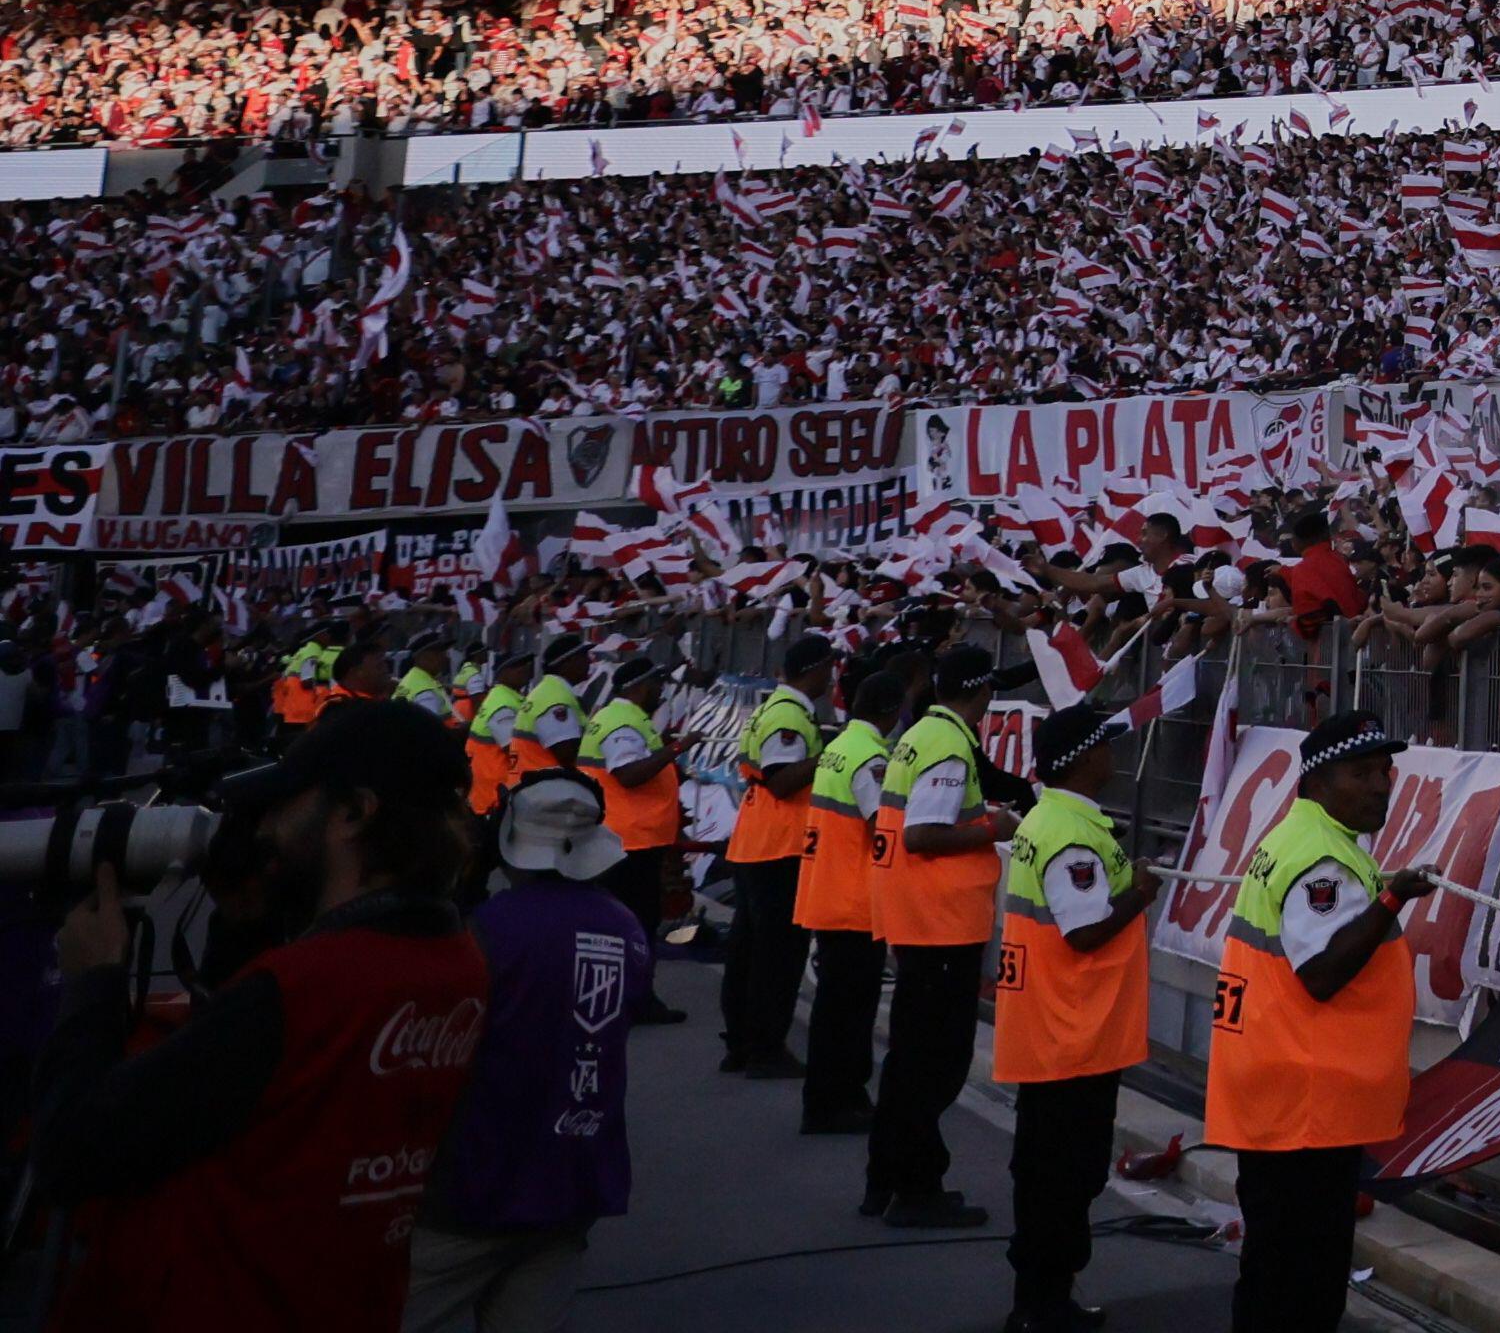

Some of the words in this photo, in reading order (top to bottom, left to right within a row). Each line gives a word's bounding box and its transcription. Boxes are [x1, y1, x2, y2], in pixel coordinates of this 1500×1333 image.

[113, 436, 318, 516] VILLA
[350, 424, 552, 511] ELISA
[630, 414, 778, 483] ARTURO
[967, 408, 1043, 498] LA
